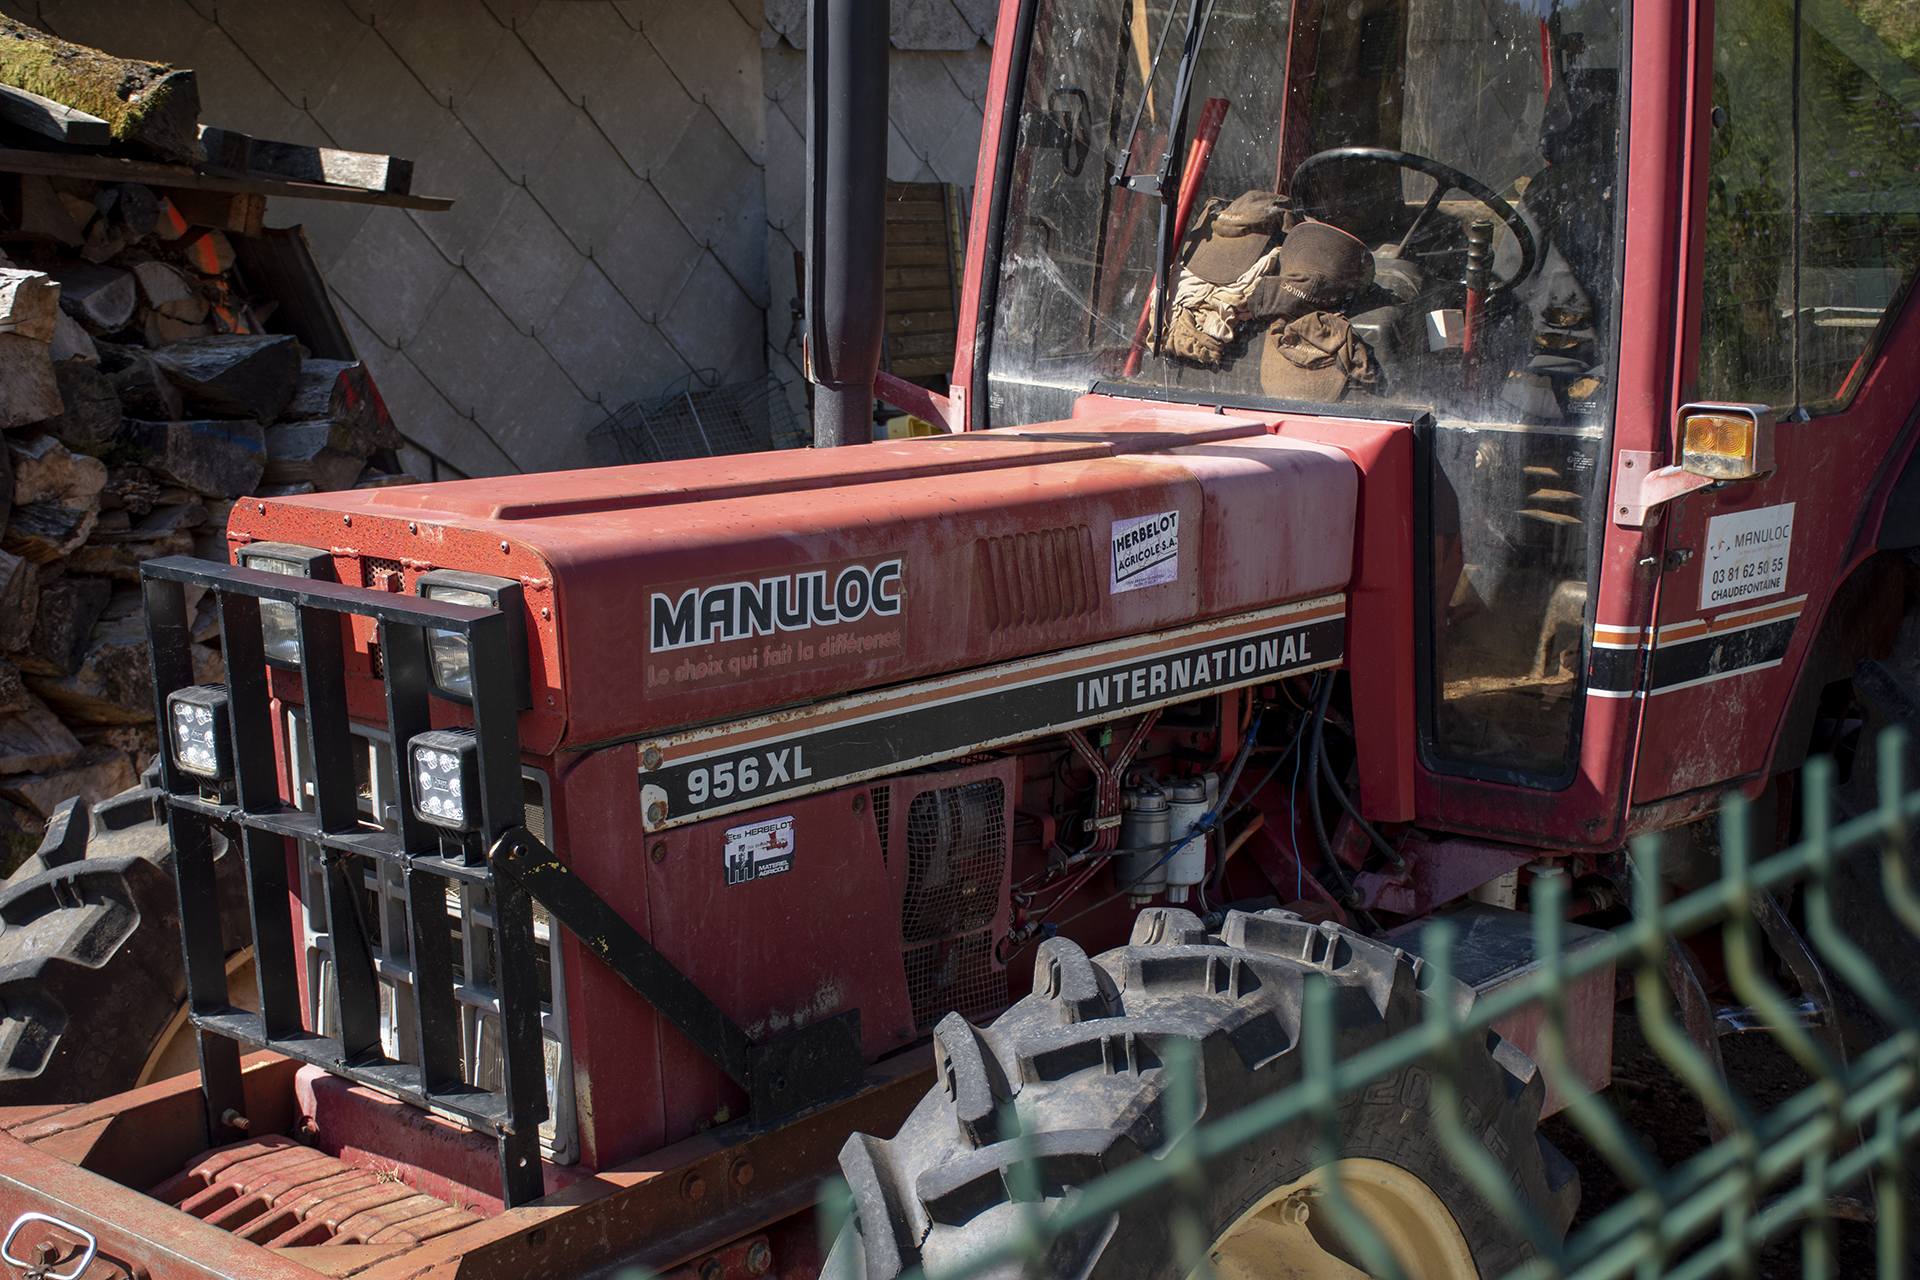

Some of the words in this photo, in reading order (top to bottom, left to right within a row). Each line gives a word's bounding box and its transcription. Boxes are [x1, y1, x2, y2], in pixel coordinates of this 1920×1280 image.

[1116, 512, 1177, 553] HERBELOT
[1734, 524, 1790, 549] MANULOC
[1118, 543, 1160, 572] AGRICOLE
[1162, 537, 1178, 551] S.A.
[1712, 569, 1726, 585] 03
[1727, 566, 1740, 582] 81
[1742, 563, 1756, 579] 62
[1757, 560, 1770, 576] 50
[1771, 556, 1784, 573] 55
[650, 559, 902, 654] MANULOC
[1711, 576, 1781, 602] CHAUDEFONTAINE
[648, 664, 670, 687] Le
[674, 653, 725, 681] choix
[728, 646, 758, 678] qui
[762, 643, 793, 667] fait
[797, 639, 814, 662] la
[818, 631, 901, 658] différence
[1075, 631, 1312, 713] INTERNATIONAL
[744, 820, 793, 838] HERBELOT
